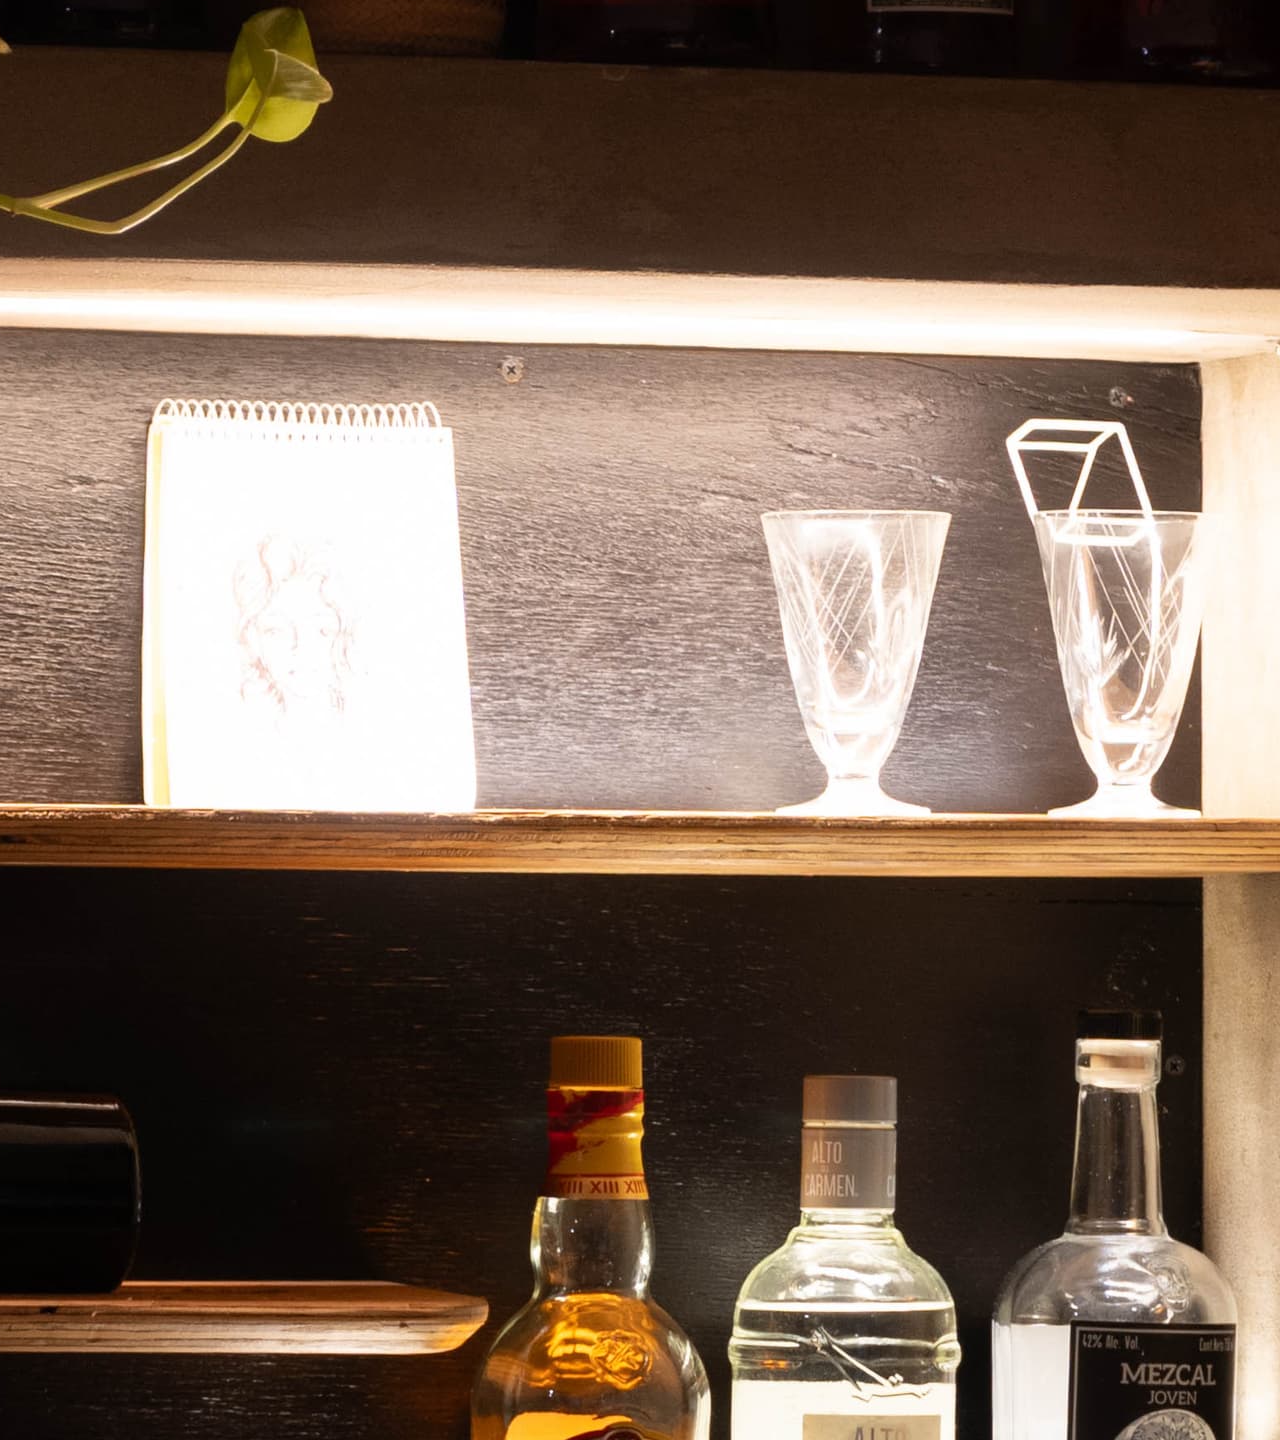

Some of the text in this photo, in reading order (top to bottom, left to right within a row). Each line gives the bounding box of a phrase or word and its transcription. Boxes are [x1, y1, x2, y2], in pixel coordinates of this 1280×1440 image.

[590, 1180, 619, 1194] XIII
[1120, 1362, 1217, 1386] MEZCAL
[1147, 1389, 1198, 1406] JOVEN
